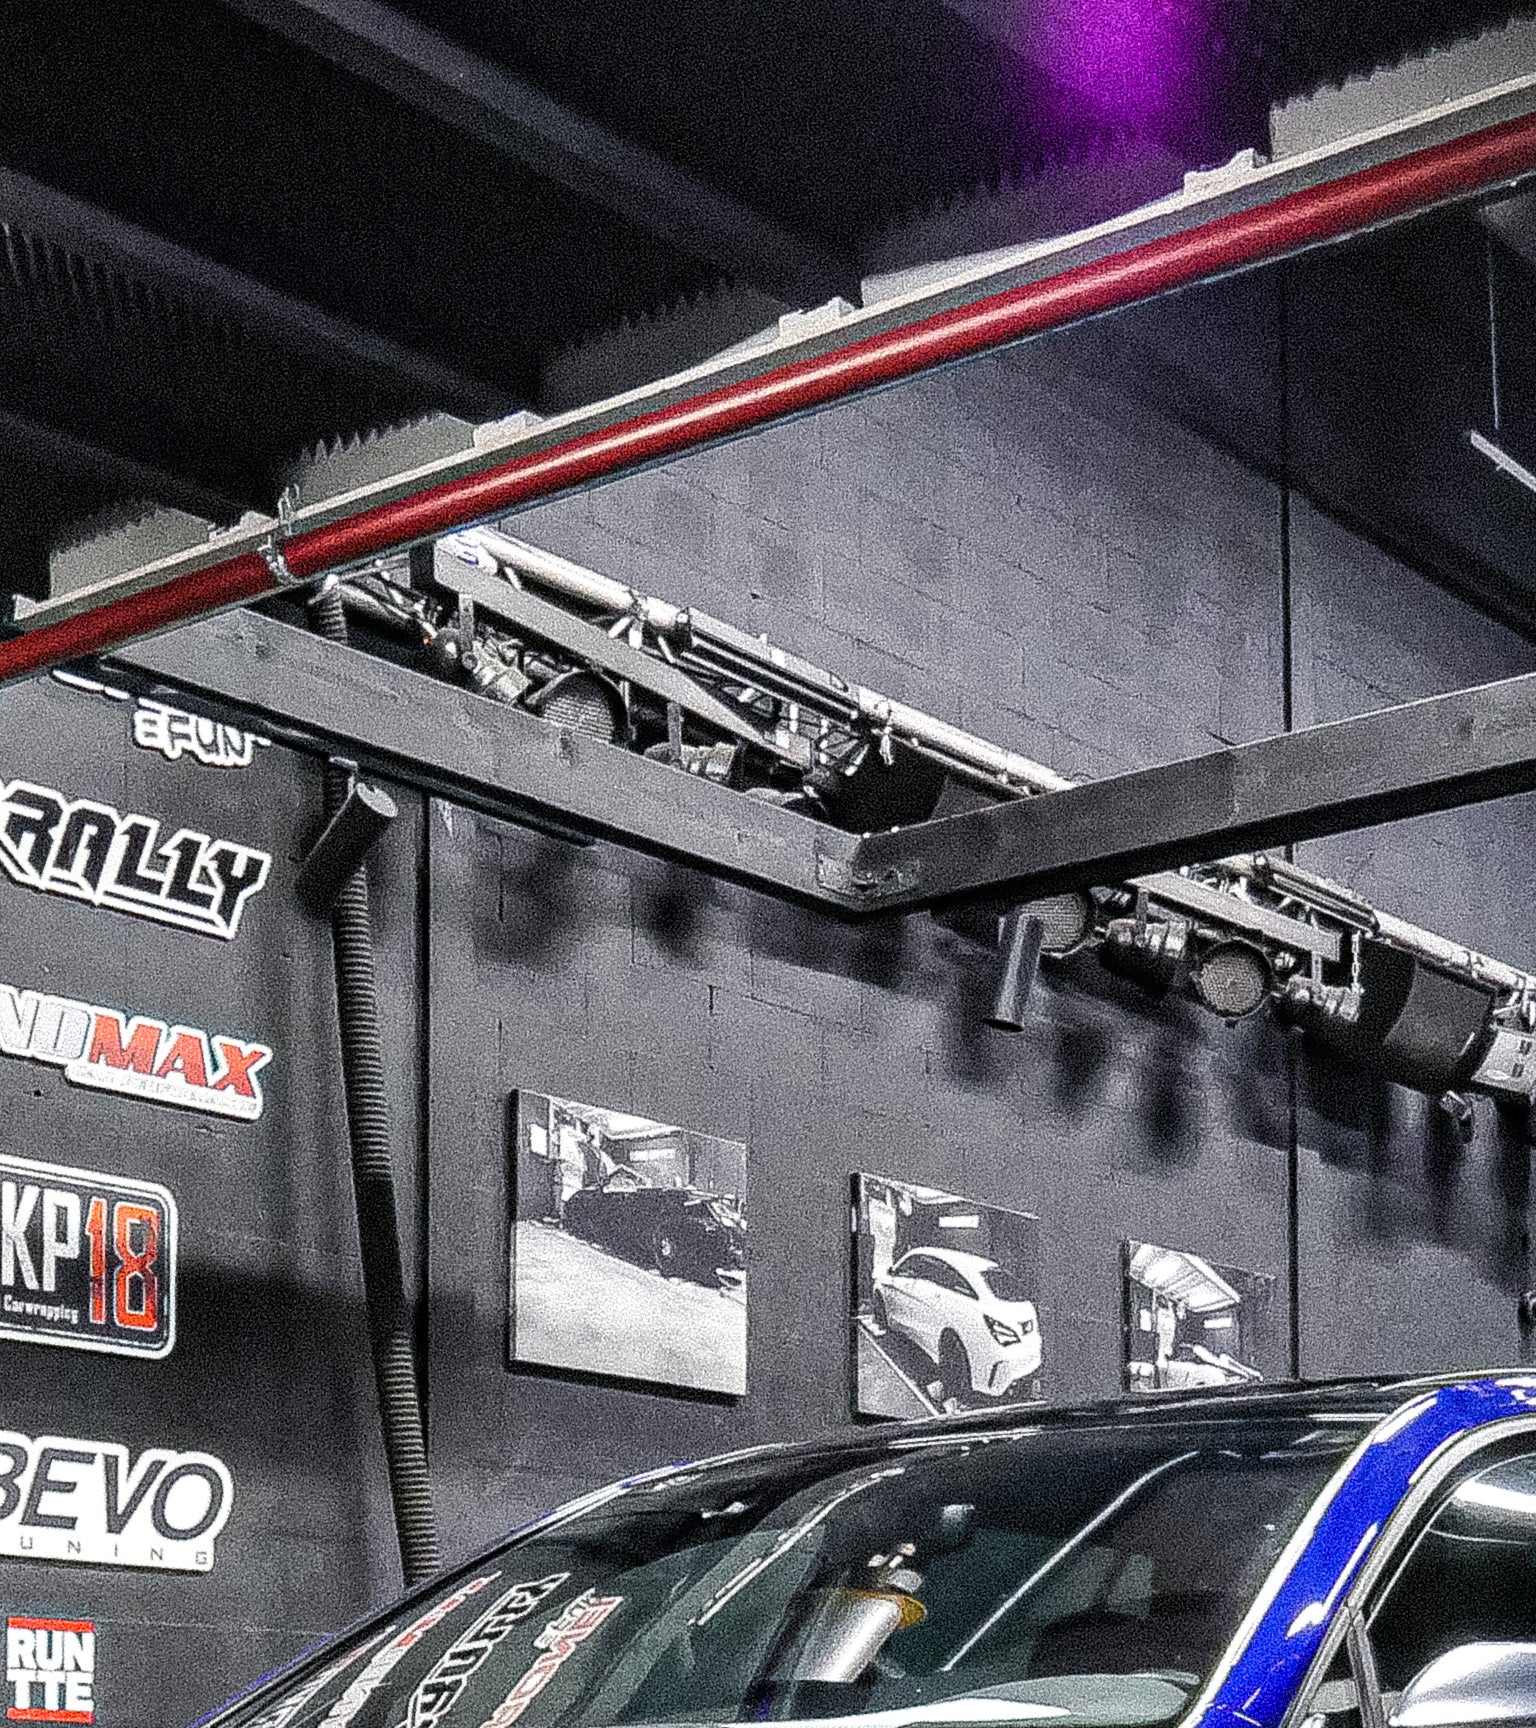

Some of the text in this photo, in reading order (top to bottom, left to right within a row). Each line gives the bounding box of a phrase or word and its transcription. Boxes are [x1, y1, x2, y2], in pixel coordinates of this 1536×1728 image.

[4, 1295, 79, 1325] Carwrapping
[7, 1628, 95, 1672] RUN
[7, 1669, 95, 1713] TTE
